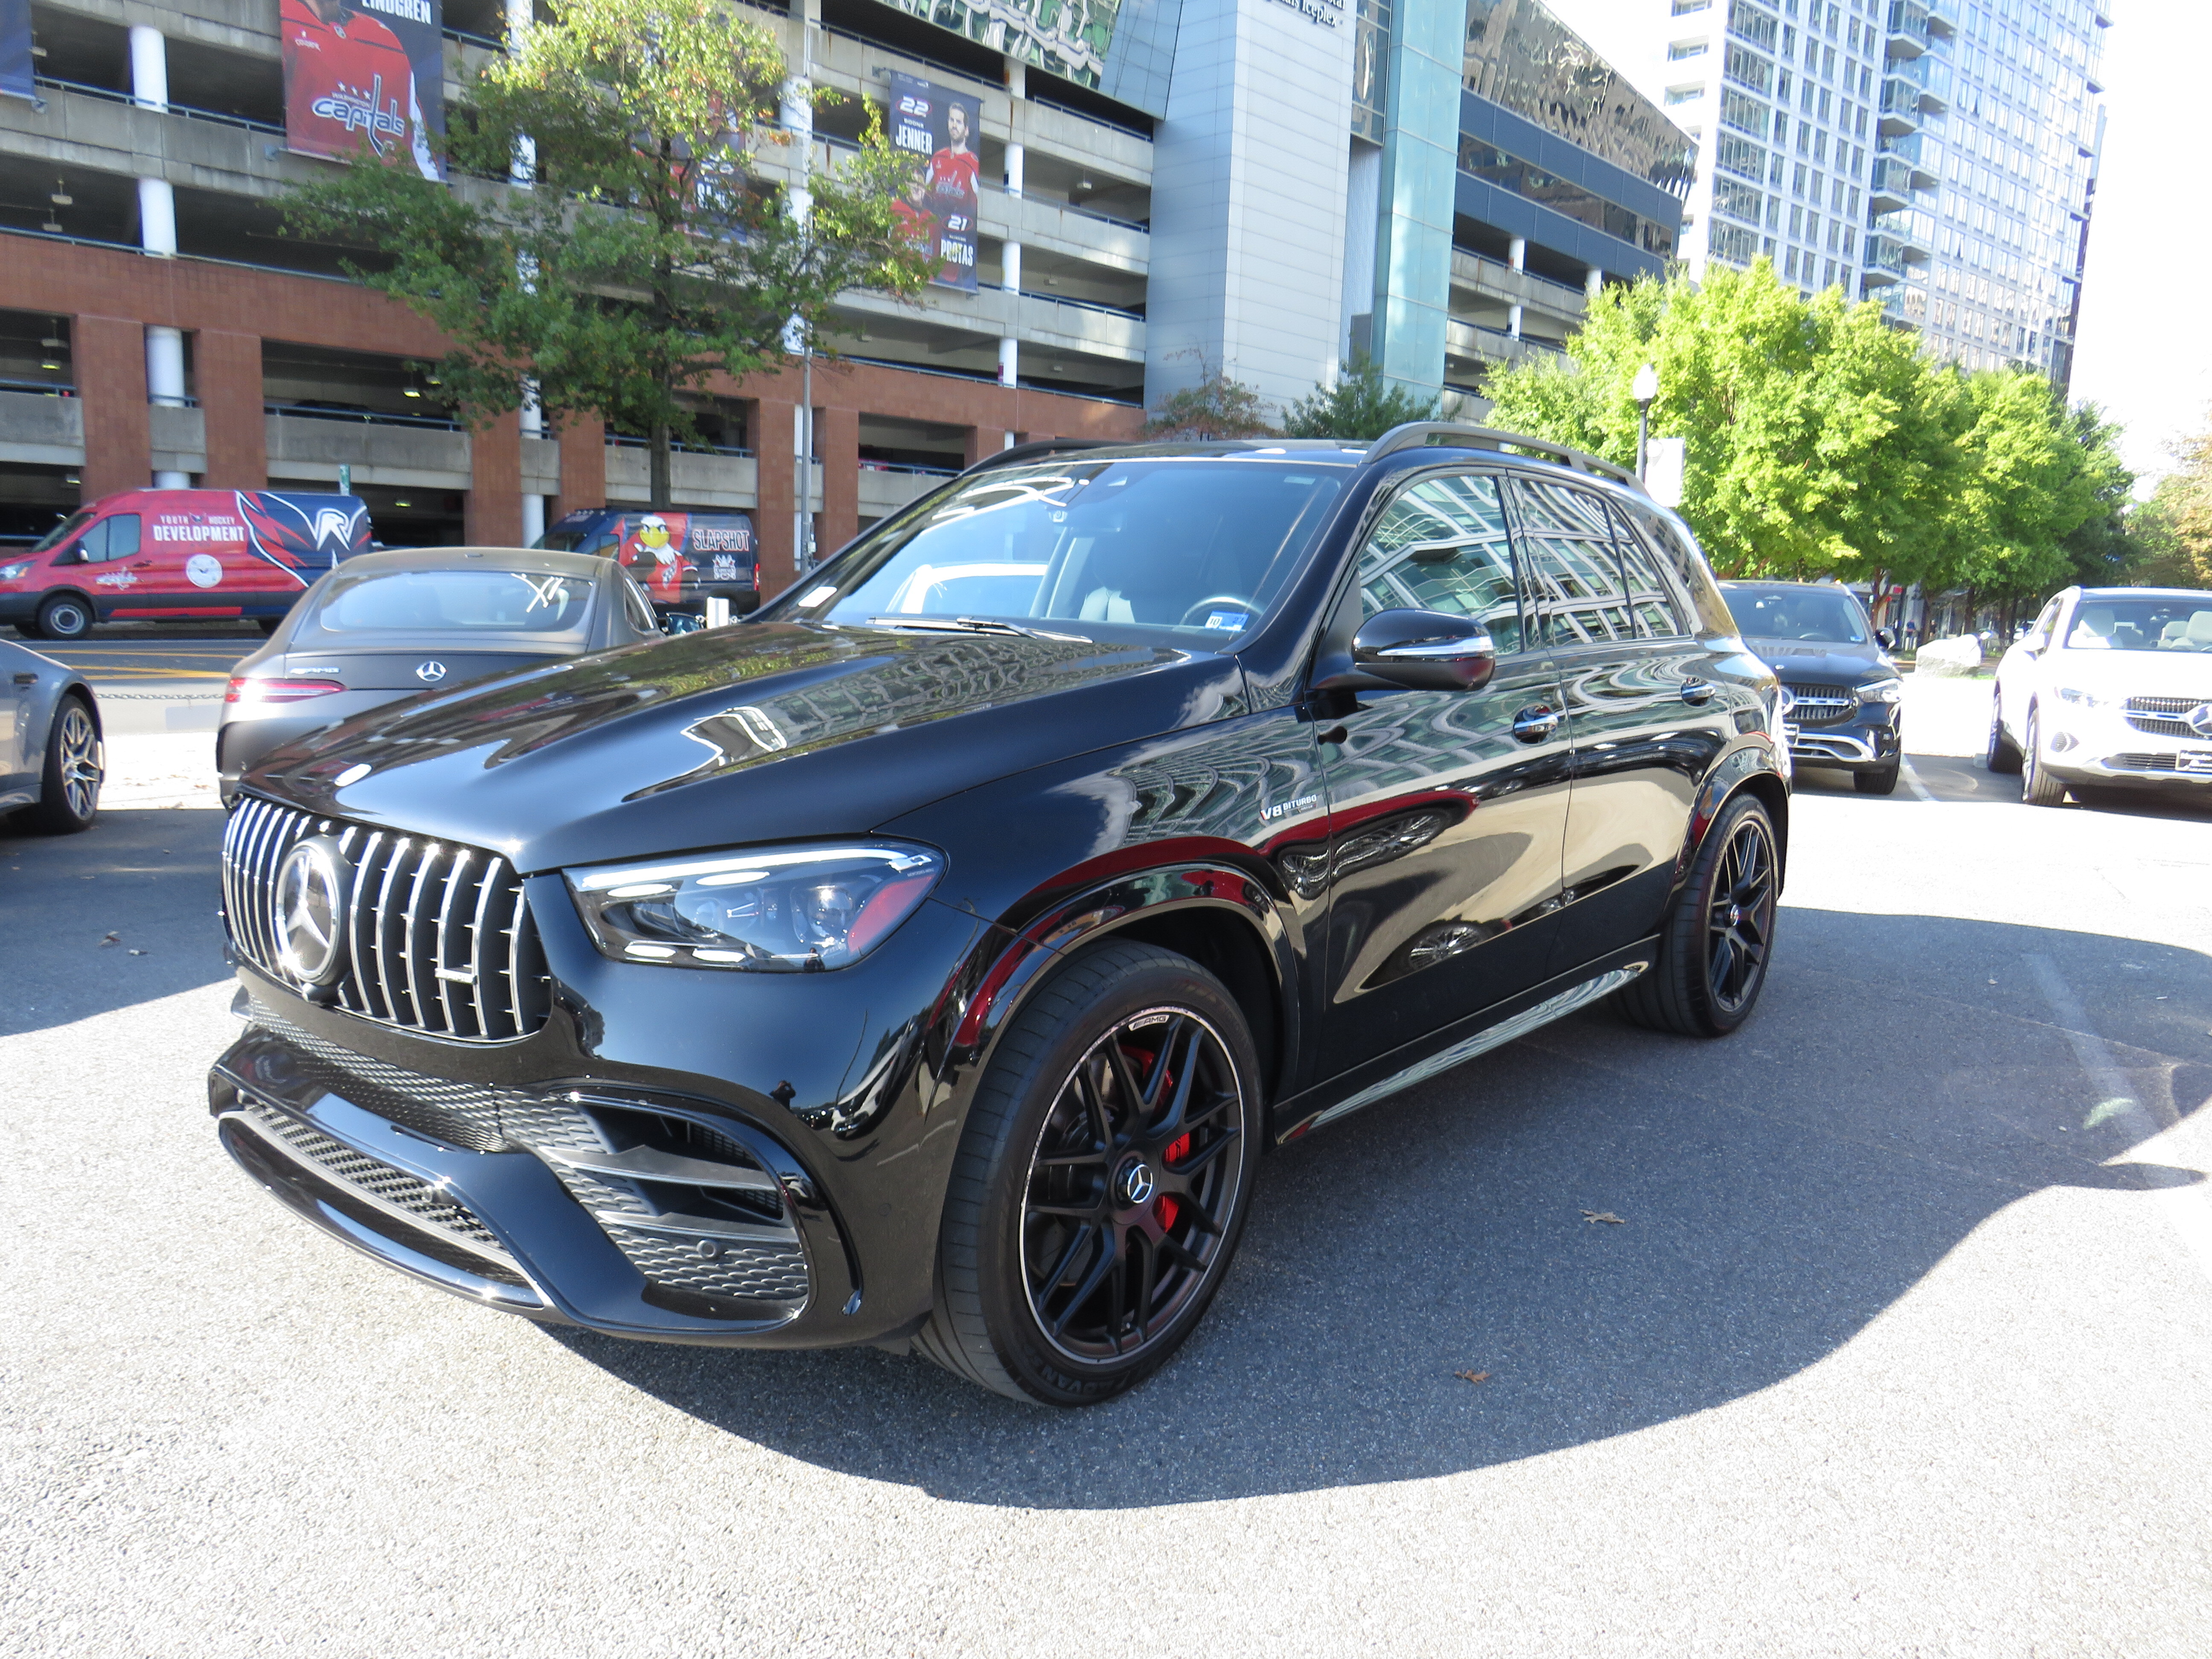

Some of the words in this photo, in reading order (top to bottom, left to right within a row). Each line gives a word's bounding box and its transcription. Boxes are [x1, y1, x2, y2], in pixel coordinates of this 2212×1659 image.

[1302, 1, 1337, 27] Iceplex
[899, 95, 929, 117] 22
[903, 118, 924, 128] BOONE
[895, 123, 933, 155] JENNER
[948, 215, 968, 231] 21
[940, 239, 973, 267] PROTAS
[160, 515, 189, 524] YOUTH
[208, 515, 235, 525] HOCKEY
[152, 525, 244, 541] DEVELOPMENT
[692, 529, 750, 552] SLAPSHOT
[1260, 804, 1282, 820] V8
[1283, 794, 1317, 811] BITURBO
[1144, 1016, 1166, 1024] AMG
